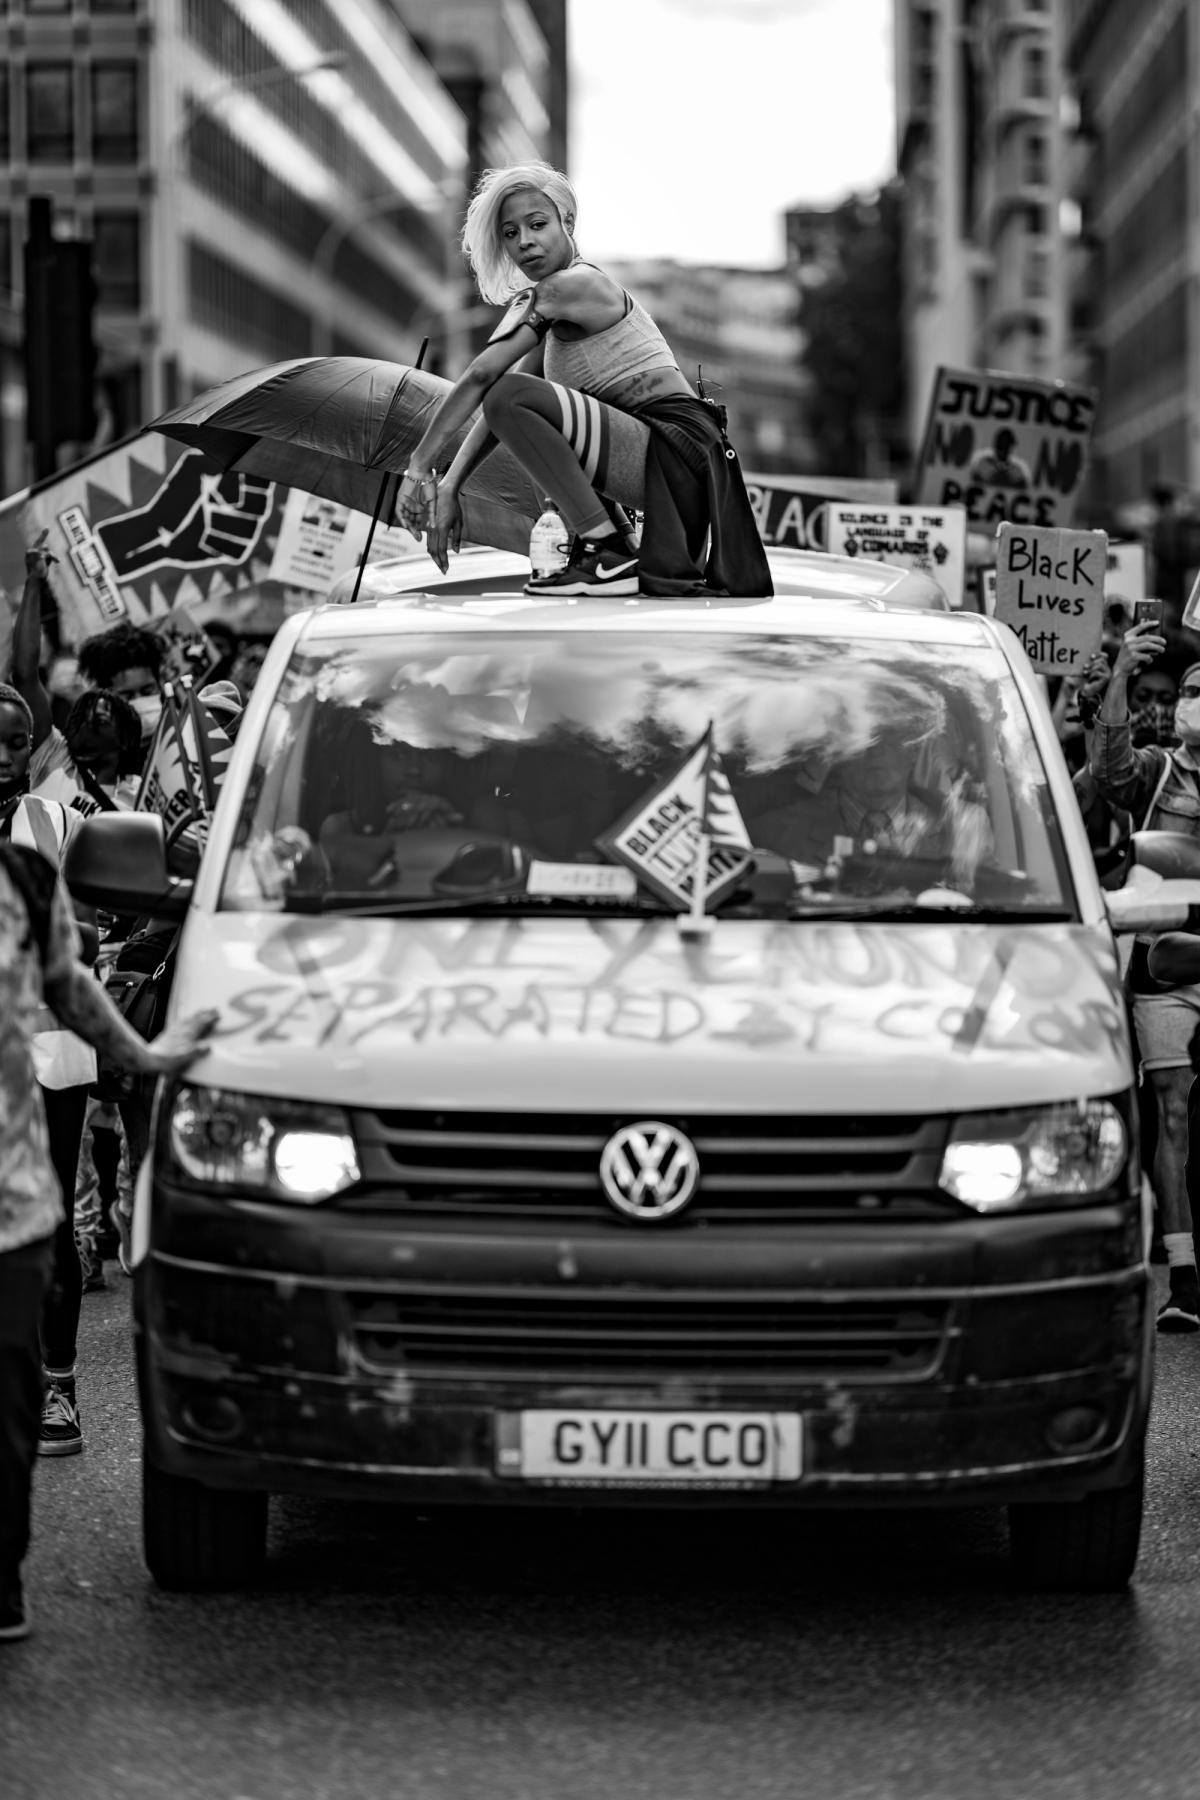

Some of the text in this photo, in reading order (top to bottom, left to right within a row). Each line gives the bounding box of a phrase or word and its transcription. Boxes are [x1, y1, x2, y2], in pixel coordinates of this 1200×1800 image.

[940, 379, 1093, 433] JUSTICE
[926, 422, 1082, 495] NO NO
[746, 485, 829, 550] BLAC
[943, 480, 1055, 528] PEACE
[1018, 579, 1085, 616] Lives
[69, 795, 102, 819] NIK
[626, 794, 694, 856] BLACK
[554, 1420, 767, 1468] GY11 CCO
